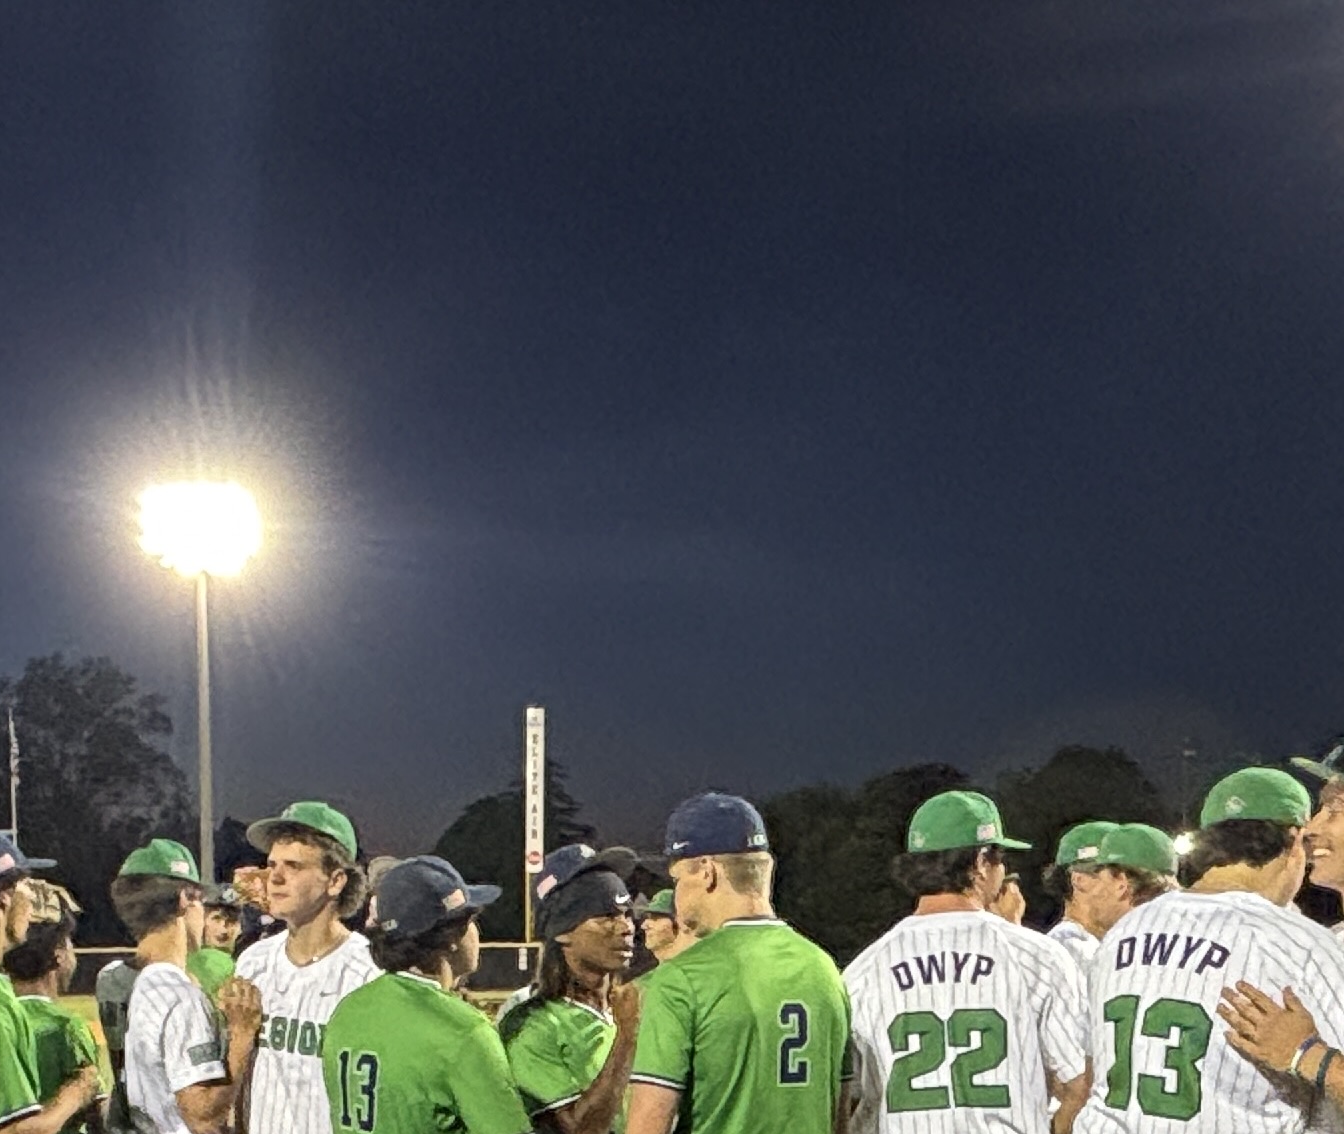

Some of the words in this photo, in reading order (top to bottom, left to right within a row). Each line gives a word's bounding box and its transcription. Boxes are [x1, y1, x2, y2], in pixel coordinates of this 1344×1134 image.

[1115, 933, 1231, 975] DWYP
[777, 999, 812, 1087] 2
[886, 1007, 1012, 1114] 22
[1104, 994, 1214, 1122] 13
[338, 1047, 381, 1134] 13
